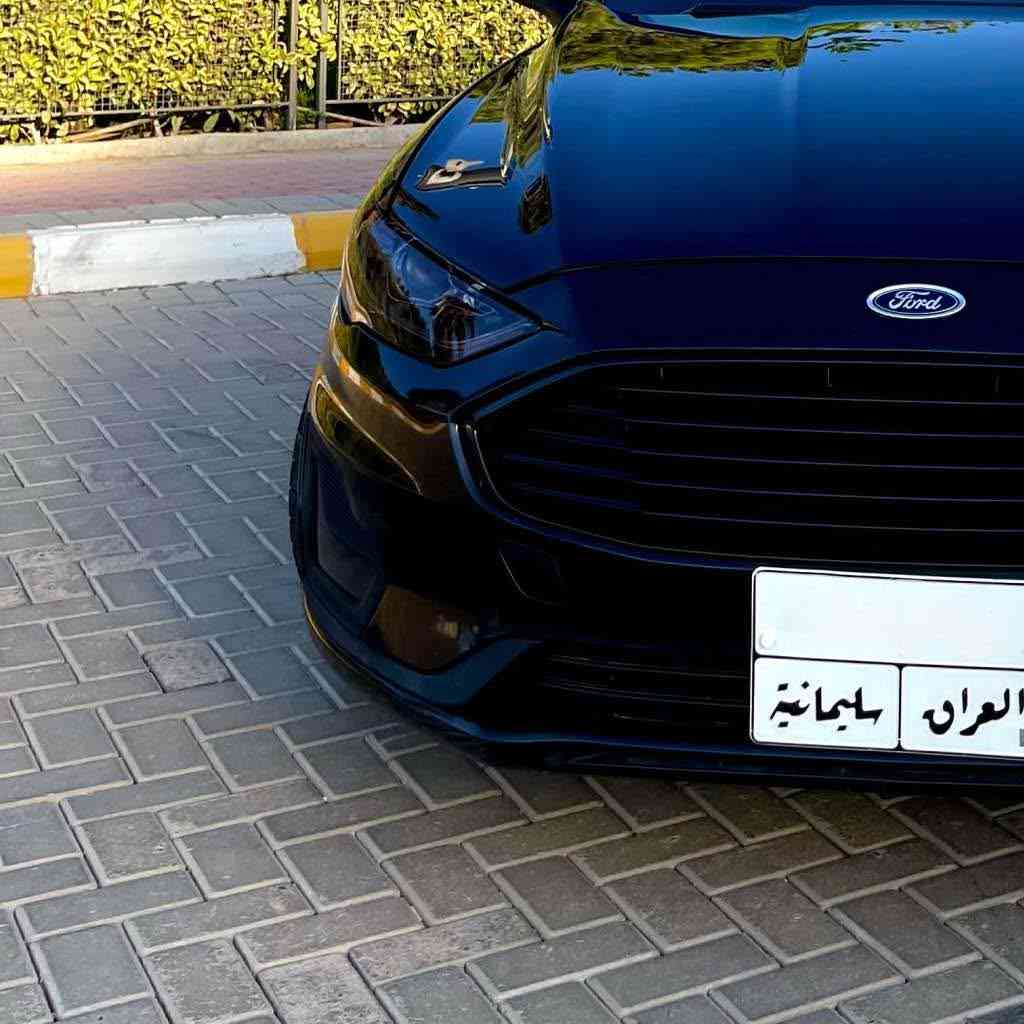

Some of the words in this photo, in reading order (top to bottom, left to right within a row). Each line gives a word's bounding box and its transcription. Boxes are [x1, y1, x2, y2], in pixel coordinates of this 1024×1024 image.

[888, 290, 943, 310] Ford
[769, 681, 884, 731] سليمانية
[922, 687, 1024, 737] العراق
